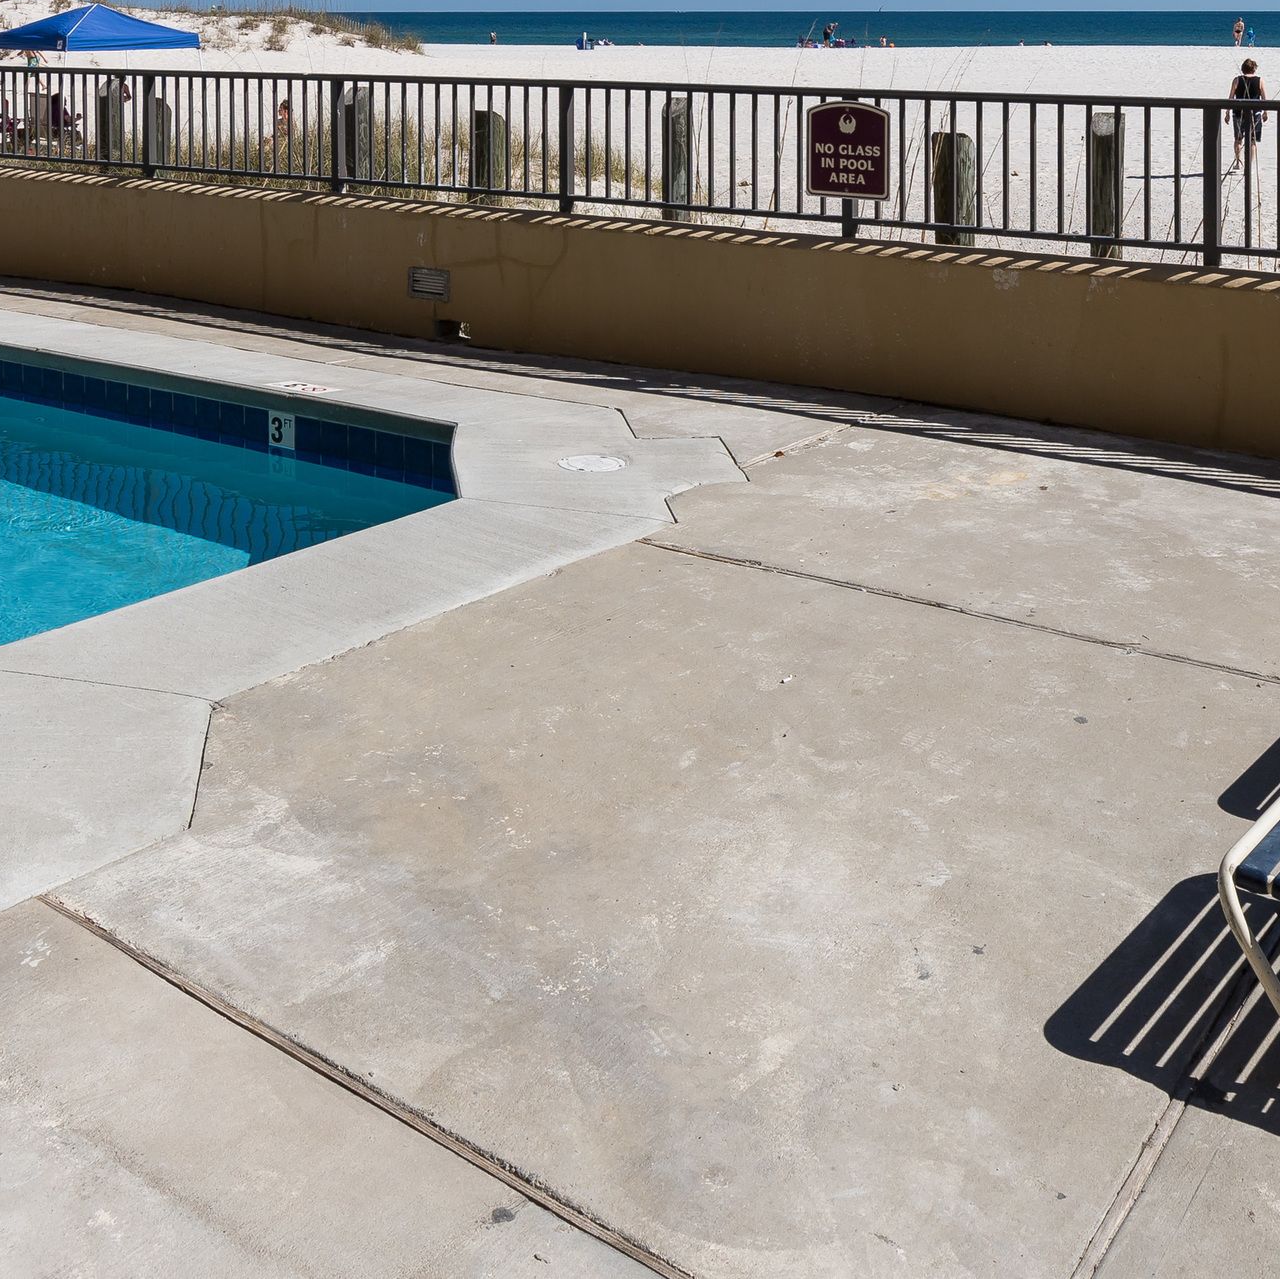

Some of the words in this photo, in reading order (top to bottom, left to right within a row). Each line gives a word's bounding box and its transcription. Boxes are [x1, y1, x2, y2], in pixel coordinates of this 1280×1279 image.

[816, 143, 834, 153] NO
[839, 144, 880, 156] GLASS
[821, 158, 834, 168] IN
[840, 159, 874, 171] POOL
[829, 173, 865, 184] AREA
[271, 417, 283, 443] 3
[284, 419, 292, 429] FT
